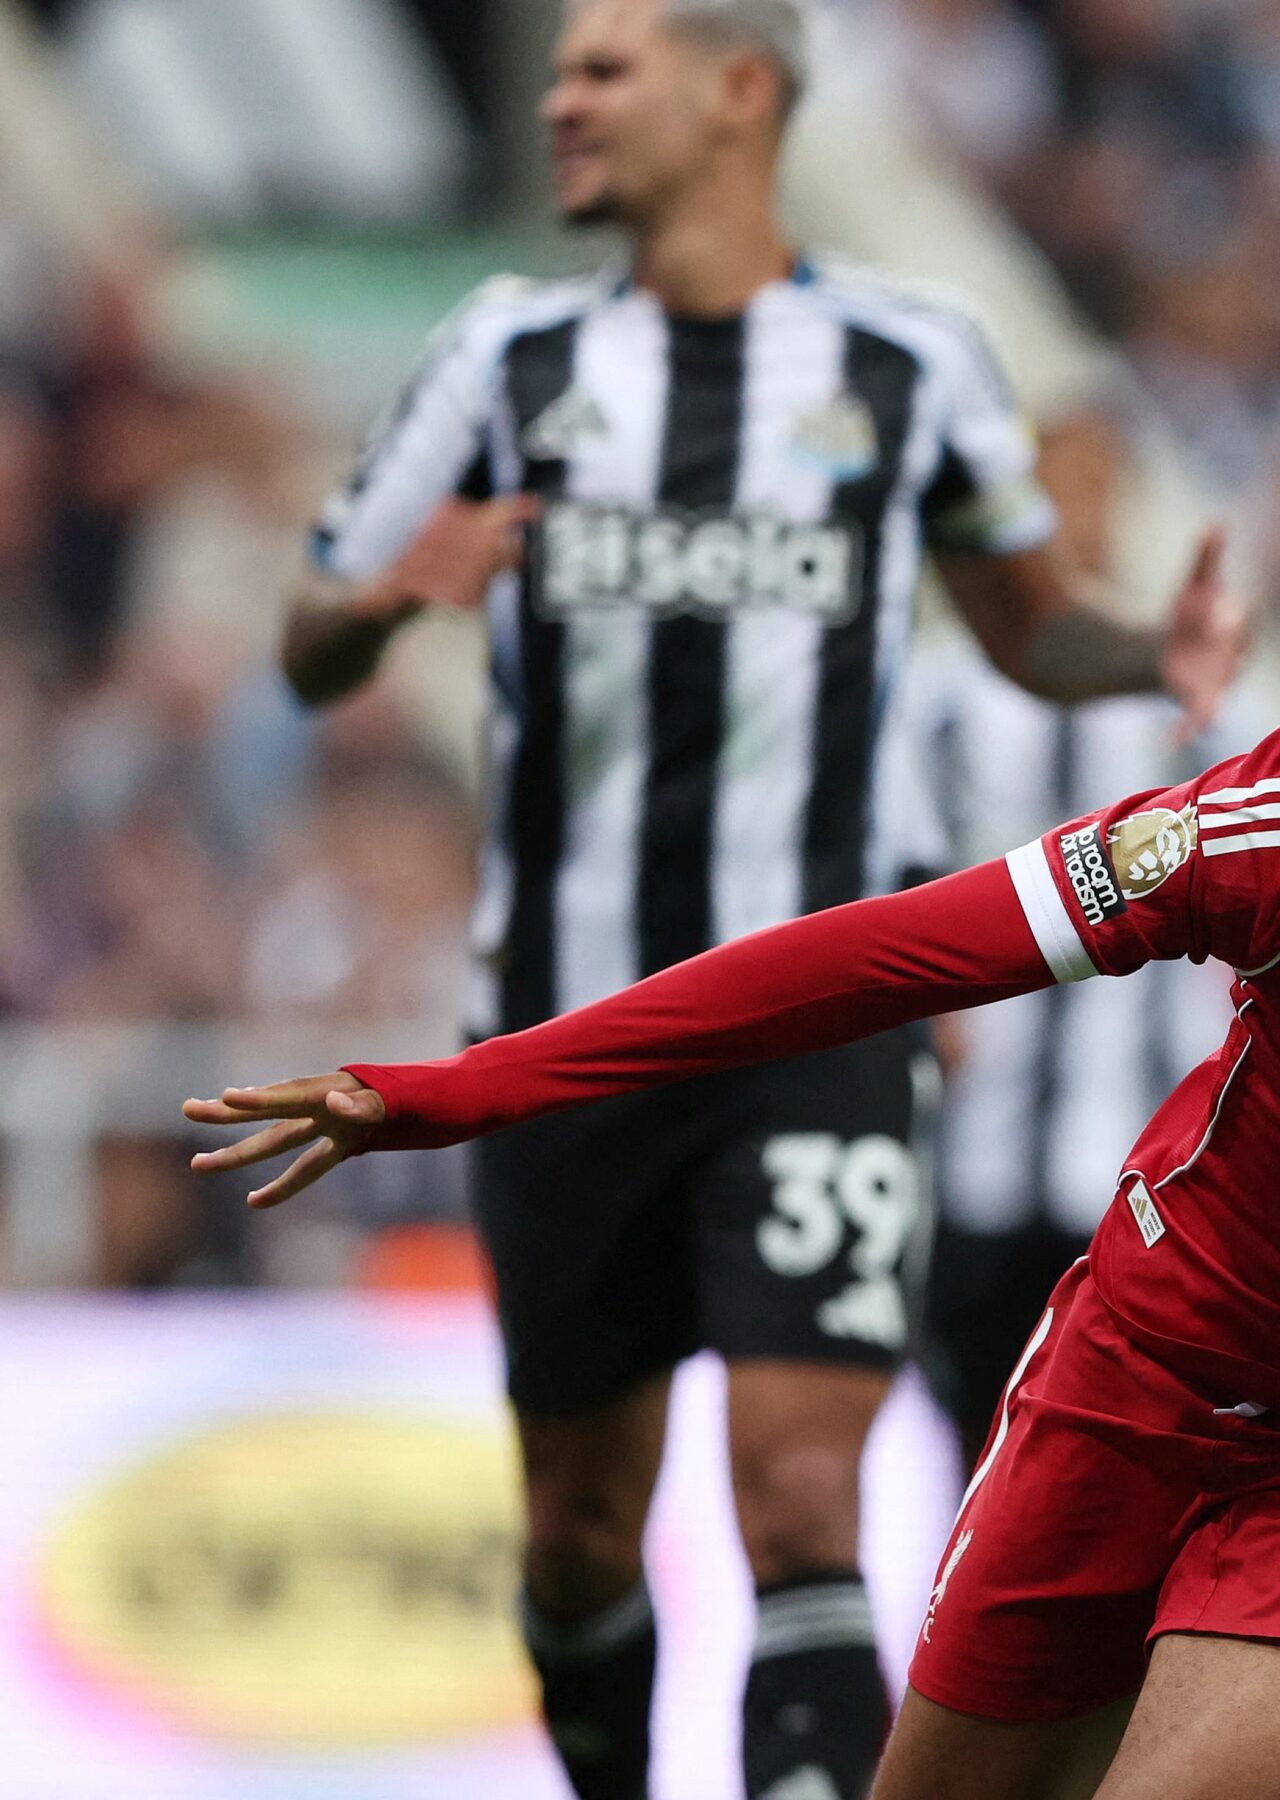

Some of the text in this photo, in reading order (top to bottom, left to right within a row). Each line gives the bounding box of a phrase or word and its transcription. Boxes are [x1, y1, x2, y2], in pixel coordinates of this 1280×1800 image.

[1065, 851, 1105, 926] racism
[1081, 843, 1119, 908] room
[755, 1131, 919, 1278] 39
